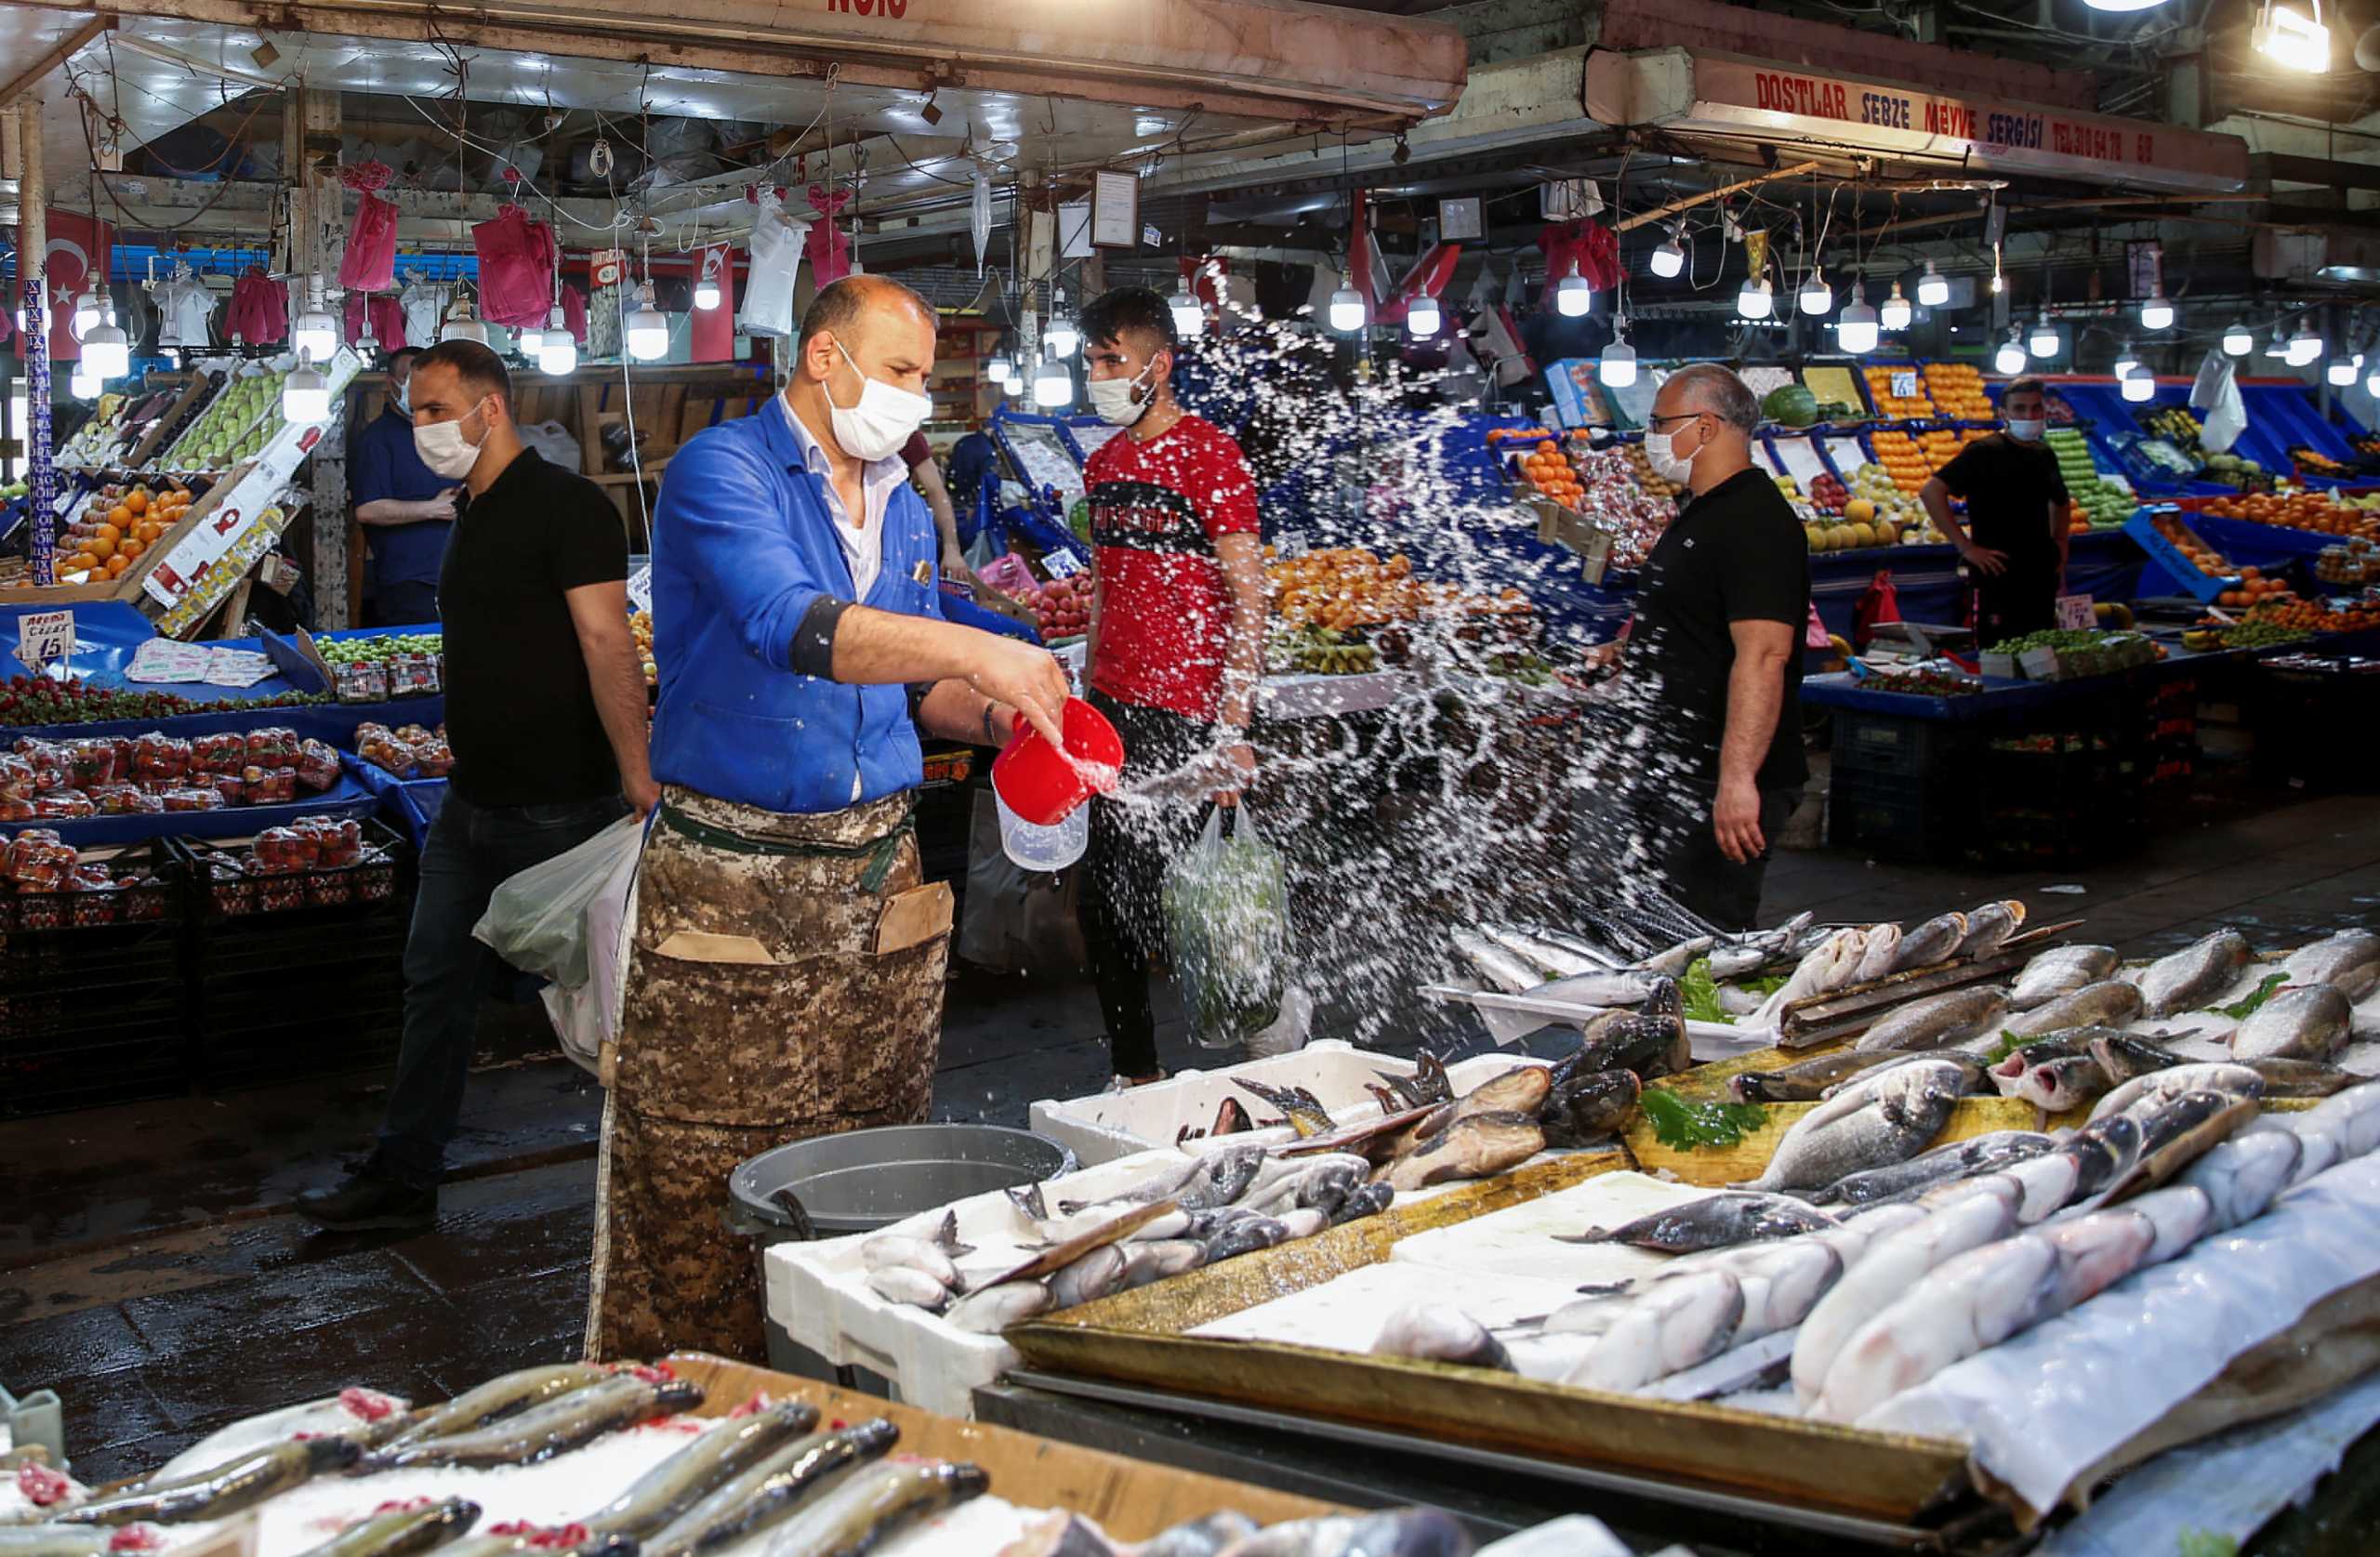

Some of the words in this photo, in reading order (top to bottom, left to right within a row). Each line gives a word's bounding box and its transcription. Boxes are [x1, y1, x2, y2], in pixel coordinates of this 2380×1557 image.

[1754, 73, 1849, 121] DOSTLAR
[1861, 92, 1911, 130] SEBZE
[1924, 101, 1977, 139] MEYVE
[1987, 112, 2043, 150] SERGİSİ
[39, 638, 61, 656] 15
